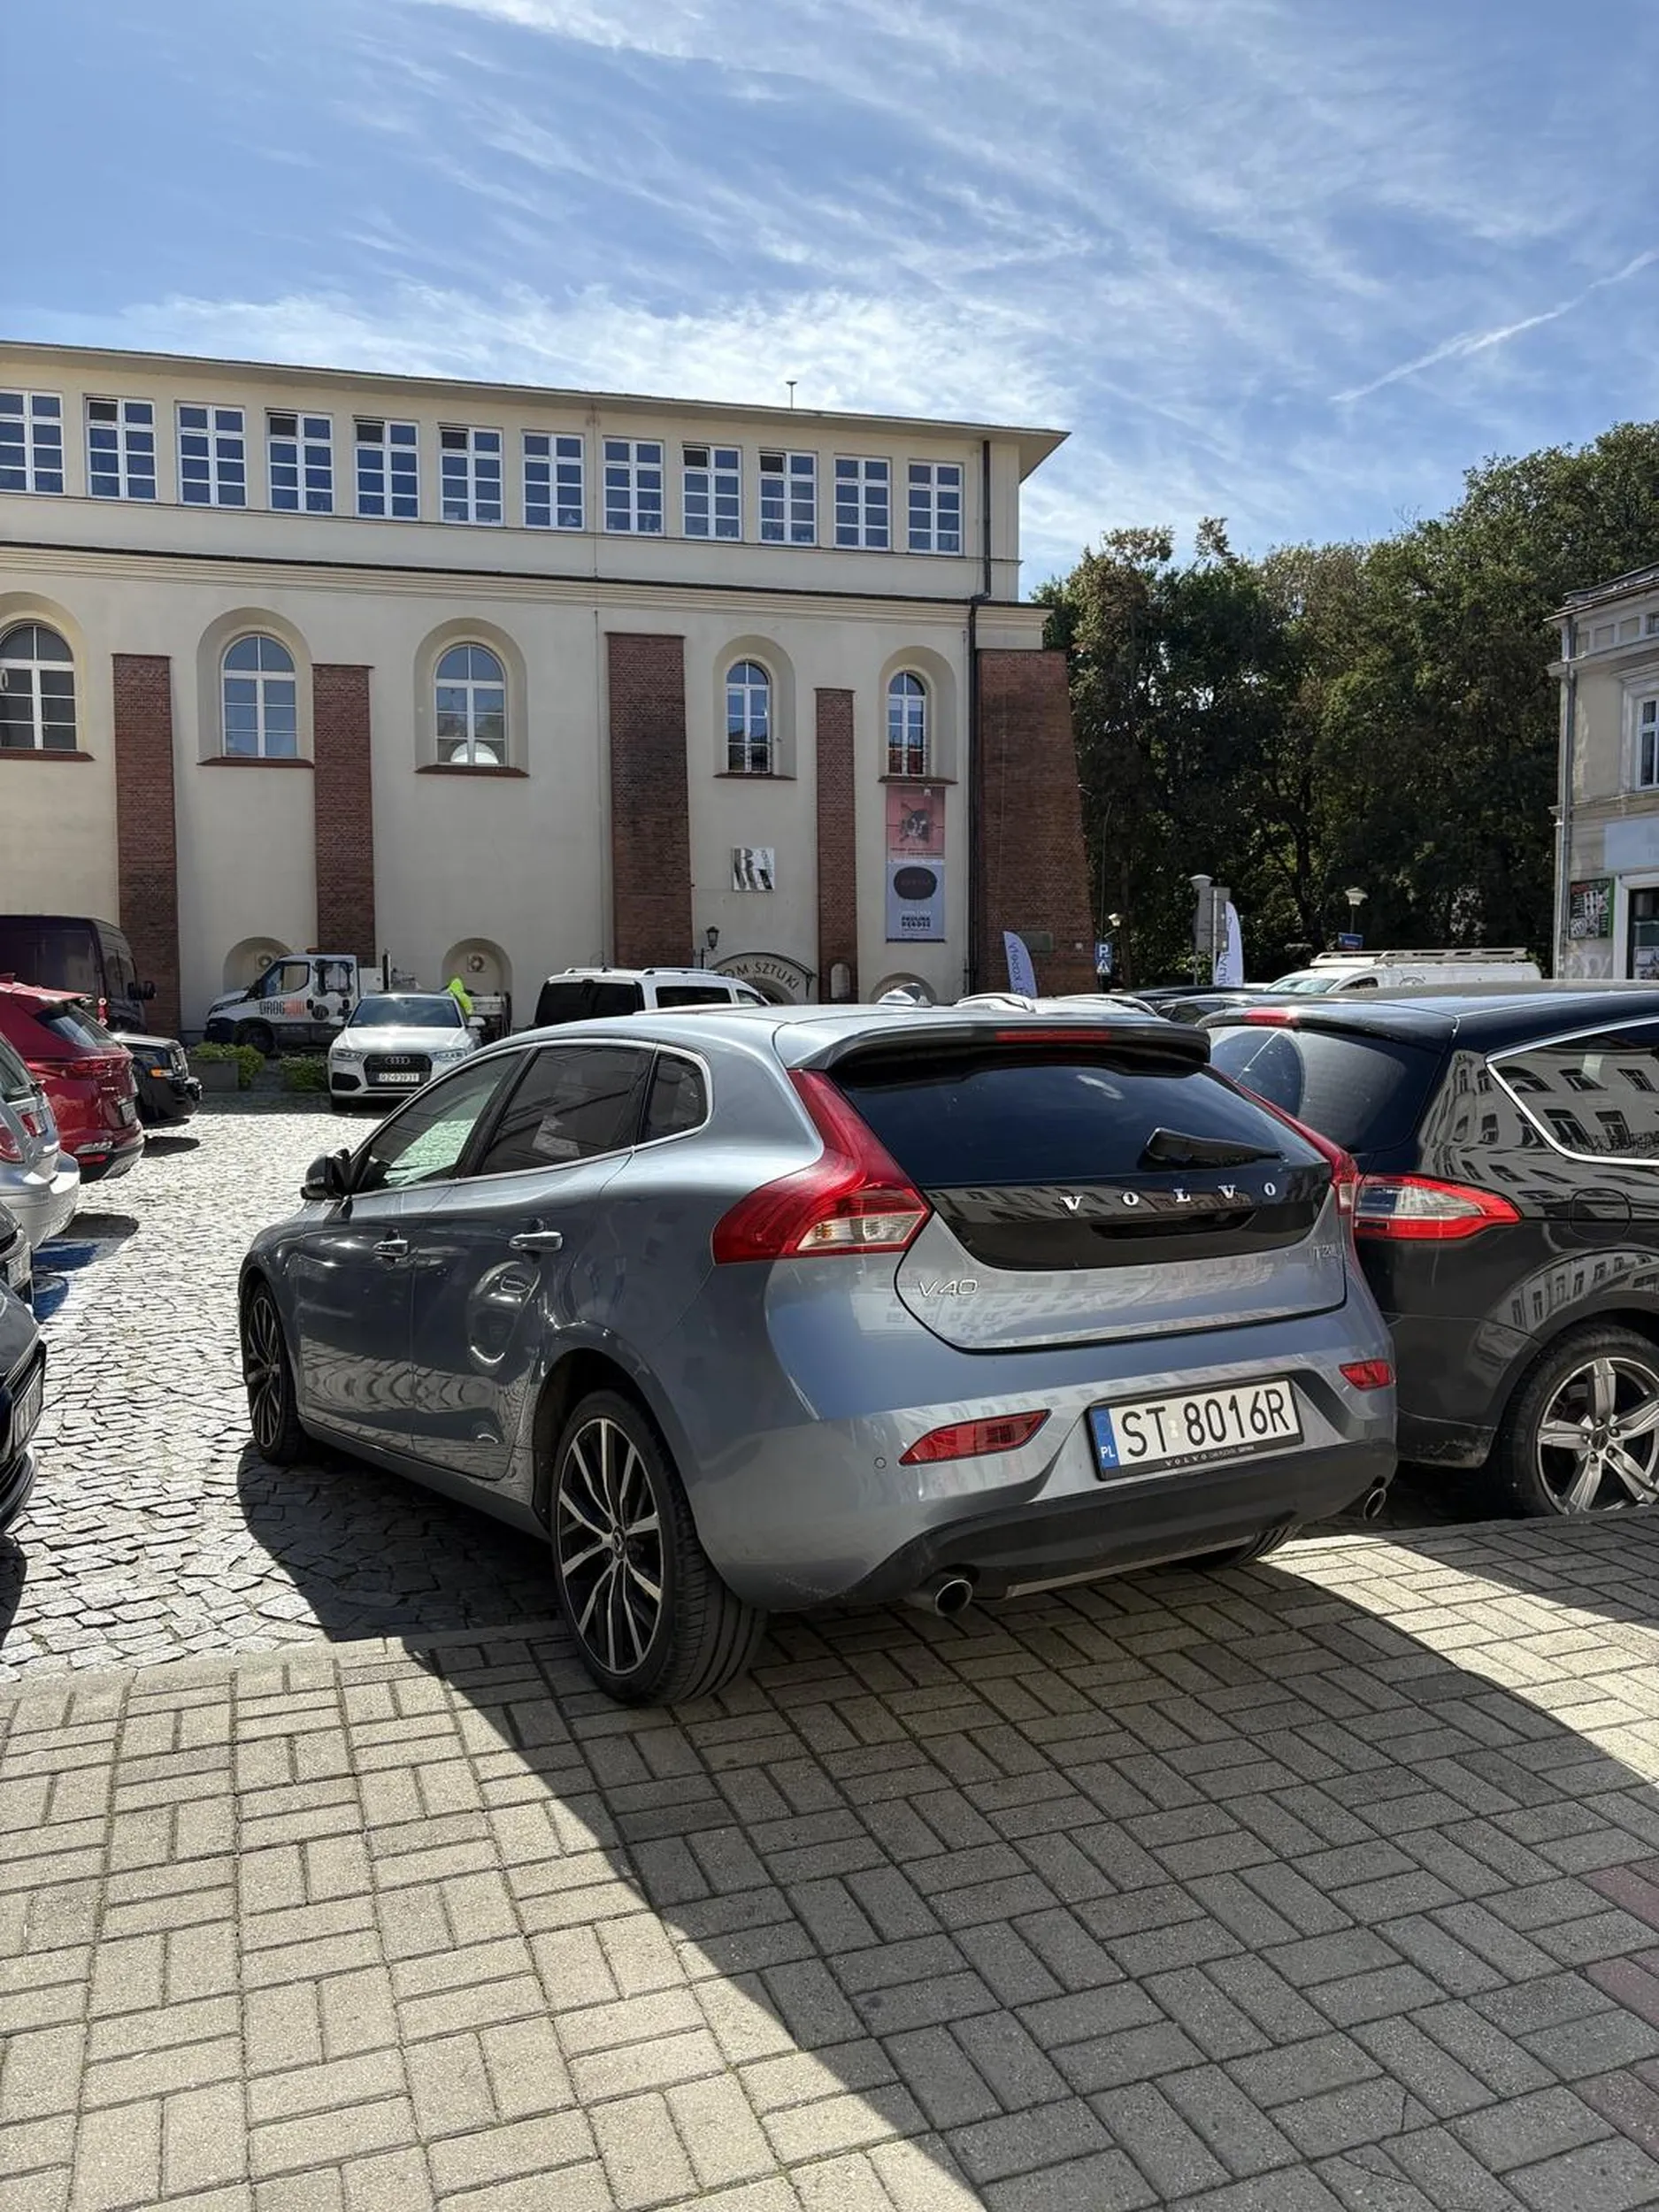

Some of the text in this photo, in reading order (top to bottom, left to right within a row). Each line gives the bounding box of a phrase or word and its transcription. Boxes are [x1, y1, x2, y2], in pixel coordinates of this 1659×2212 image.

[1099, 944, 1109, 957] P
[755, 963, 799, 989] SZTUKI
[1061, 1182, 1276, 1210] VOLVO
[918, 1279, 979, 1298] V40
[1100, 1388, 1290, 1459] PL ST 8016R
[1164, 1454, 1208, 1467] VOLVO
